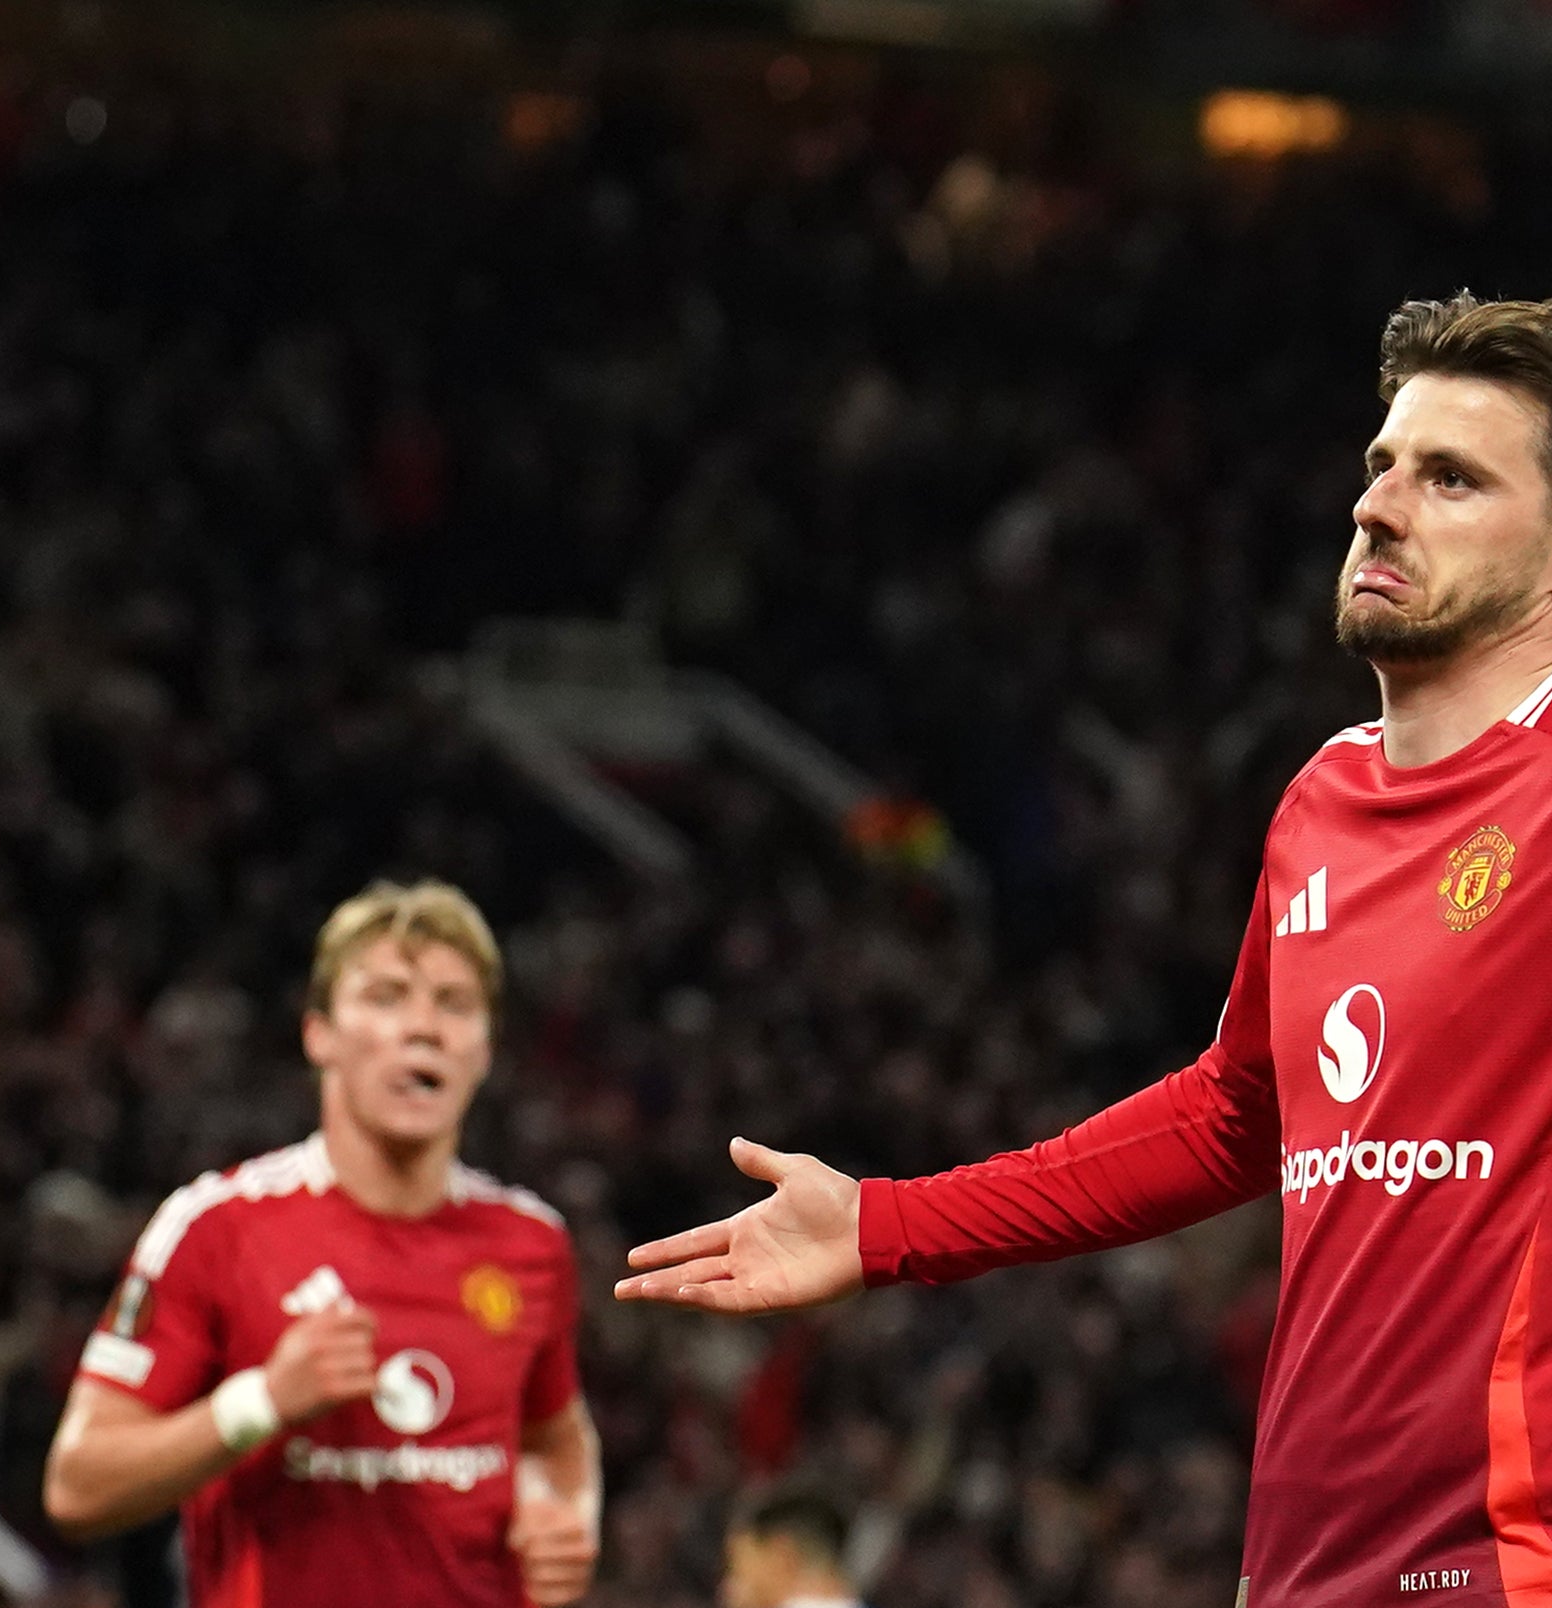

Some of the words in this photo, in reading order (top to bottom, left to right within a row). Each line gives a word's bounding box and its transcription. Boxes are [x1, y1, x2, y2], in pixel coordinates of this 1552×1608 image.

[1451, 833, 1511, 869] MANCHESTER
[1445, 904, 1488, 924] UNITED
[1399, 1569, 1471, 1592] HEAT.RDY
